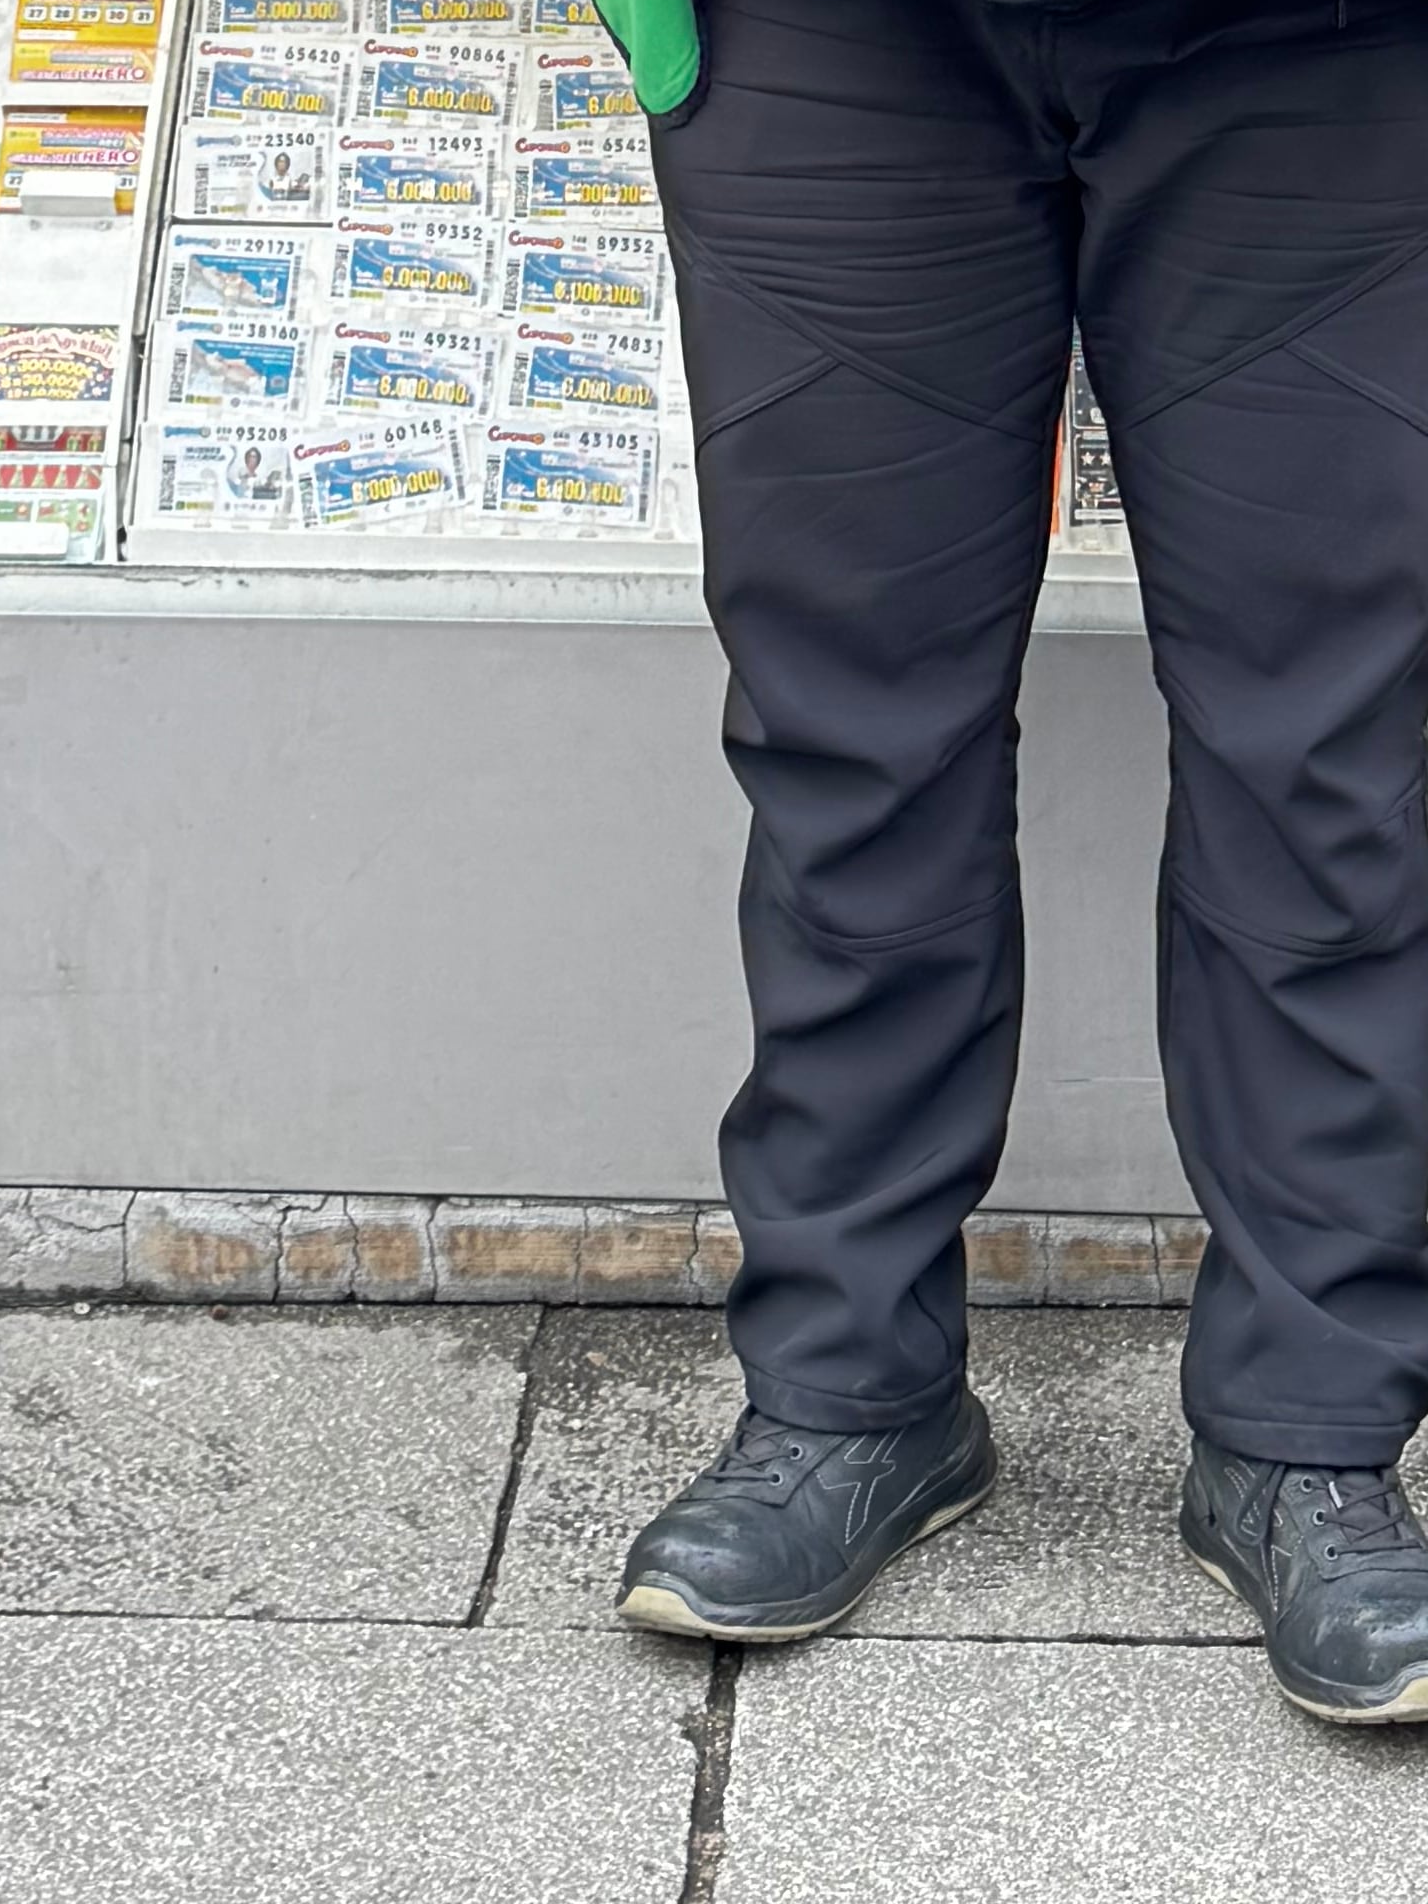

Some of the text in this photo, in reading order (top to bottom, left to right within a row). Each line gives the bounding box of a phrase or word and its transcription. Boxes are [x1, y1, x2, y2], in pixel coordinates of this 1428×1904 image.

[284, 45, 341, 64] 65420
[449, 45, 506, 63] 90864
[264, 132, 315, 147] 23540
[428, 136, 484, 152] 12493
[602, 138, 648, 153] 6542
[425, 222, 484, 240] 89352
[244, 238, 295, 255] 29173
[596, 234, 655, 254] 89352
[246, 322, 299, 340] 38160
[423, 331, 483, 350] 49321
[384, 418, 443, 444] 60148
[578, 430, 639, 451] 43105
